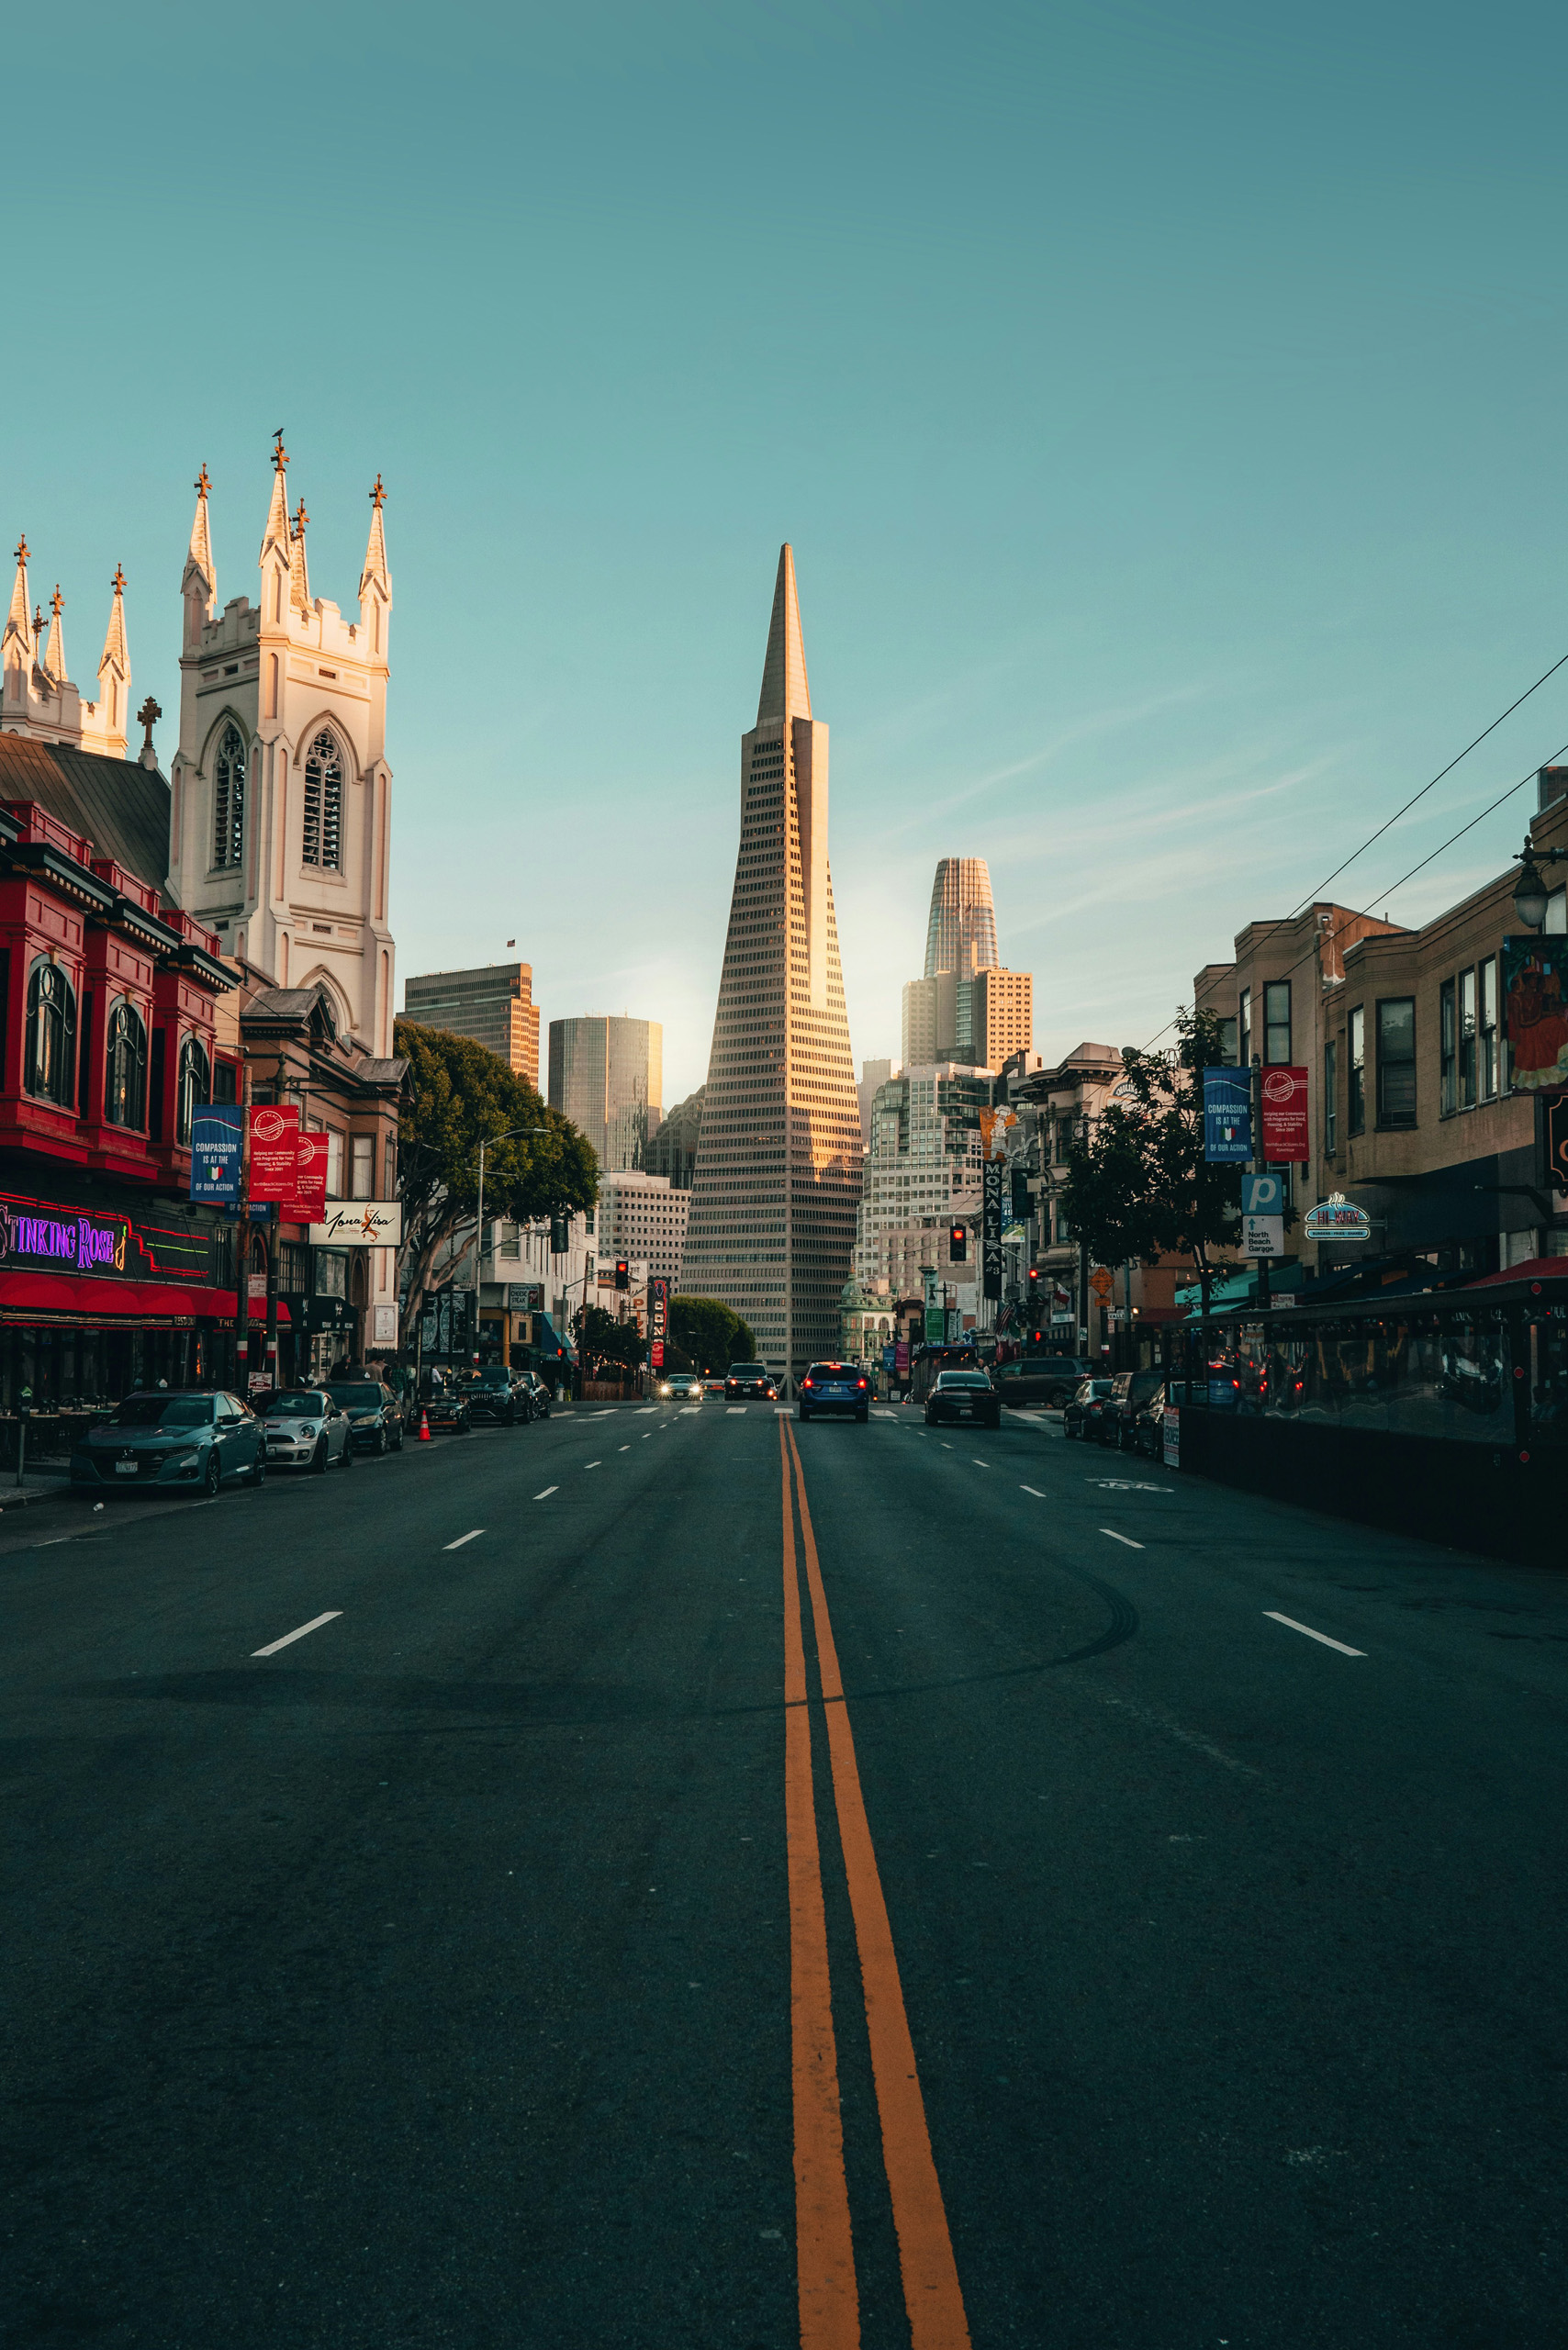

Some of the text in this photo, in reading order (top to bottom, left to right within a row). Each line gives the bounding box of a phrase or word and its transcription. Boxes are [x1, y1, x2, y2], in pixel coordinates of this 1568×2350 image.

[1207, 1104, 1248, 1114] COMPASSION
[1215, 1116, 1240, 1125] IS AT THE
[196, 1143, 237, 1153] COMPASSION
[1210, 1144, 1248, 1152] OF OUR ACTION
[203, 1155, 229, 1165] IS AT THE
[196, 1183, 234, 1192] OF OUR ACTION
[985, 1163, 1001, 1210] MONA
[230, 1203, 236, 1212] OF
[361, 1210, 396, 1236] Lisa
[985, 1215, 1001, 1263] LISA
[1248, 1246, 1275, 1254] Garage
[985, 1266, 1001, 1276] #3
[218, 1318, 235, 1327] THE
